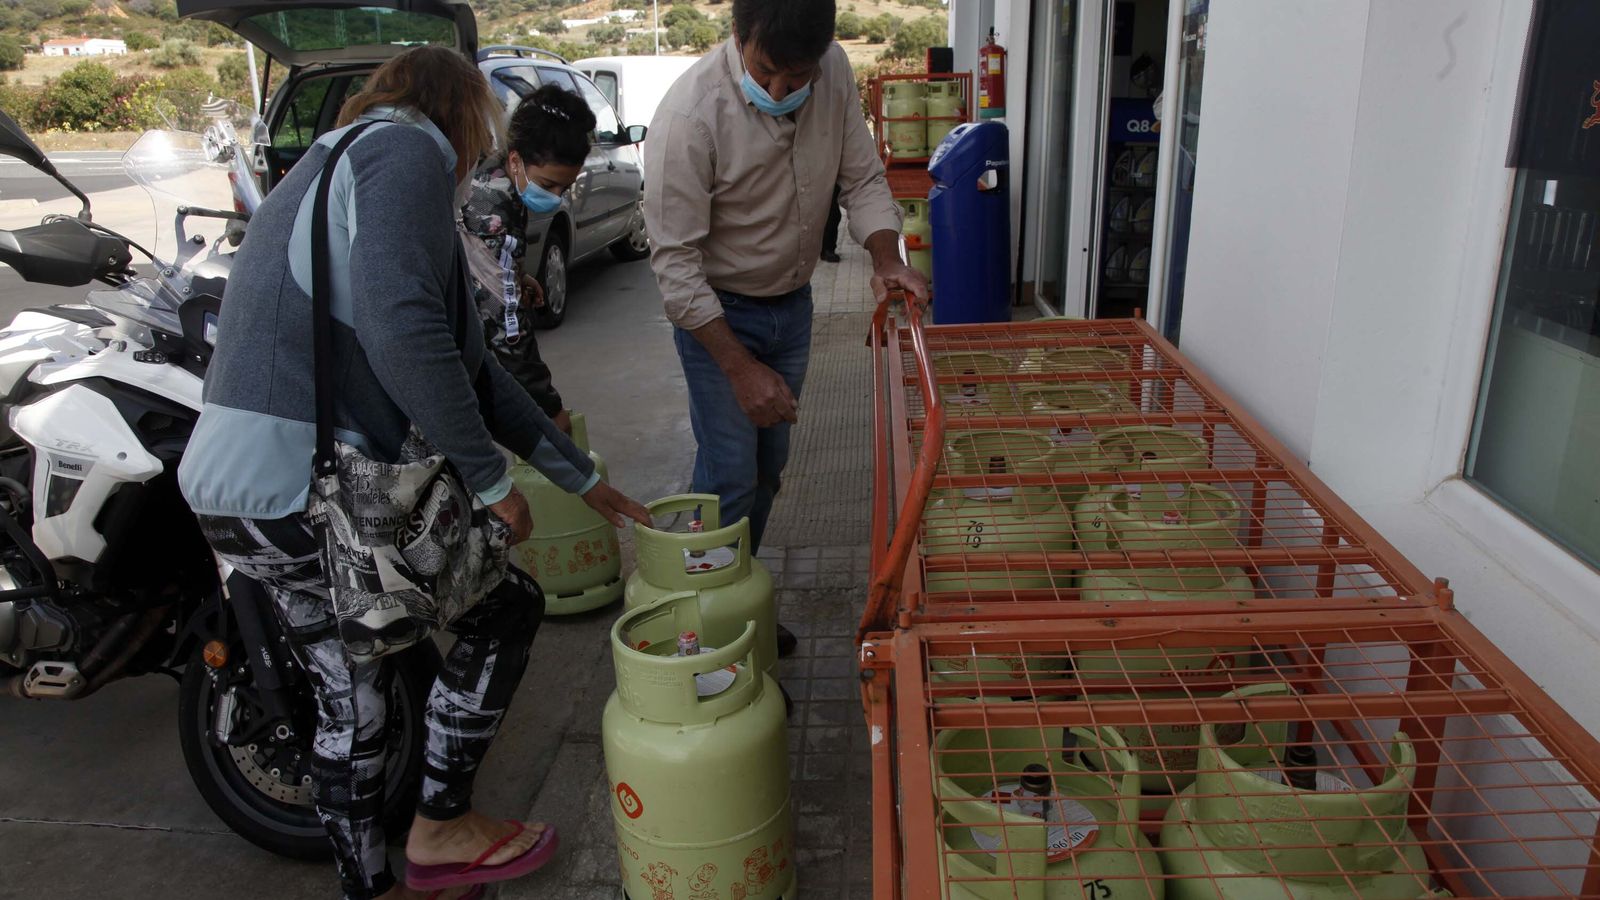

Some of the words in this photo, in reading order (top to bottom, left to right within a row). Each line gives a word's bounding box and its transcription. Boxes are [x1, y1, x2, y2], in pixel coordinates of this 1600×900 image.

[1127, 119, 1150, 132] Q8
[55, 438, 94, 453] TRX
[58, 460, 83, 472] Benelli
[967, 520, 984, 533] 76
[1083, 878, 1112, 900] 75
